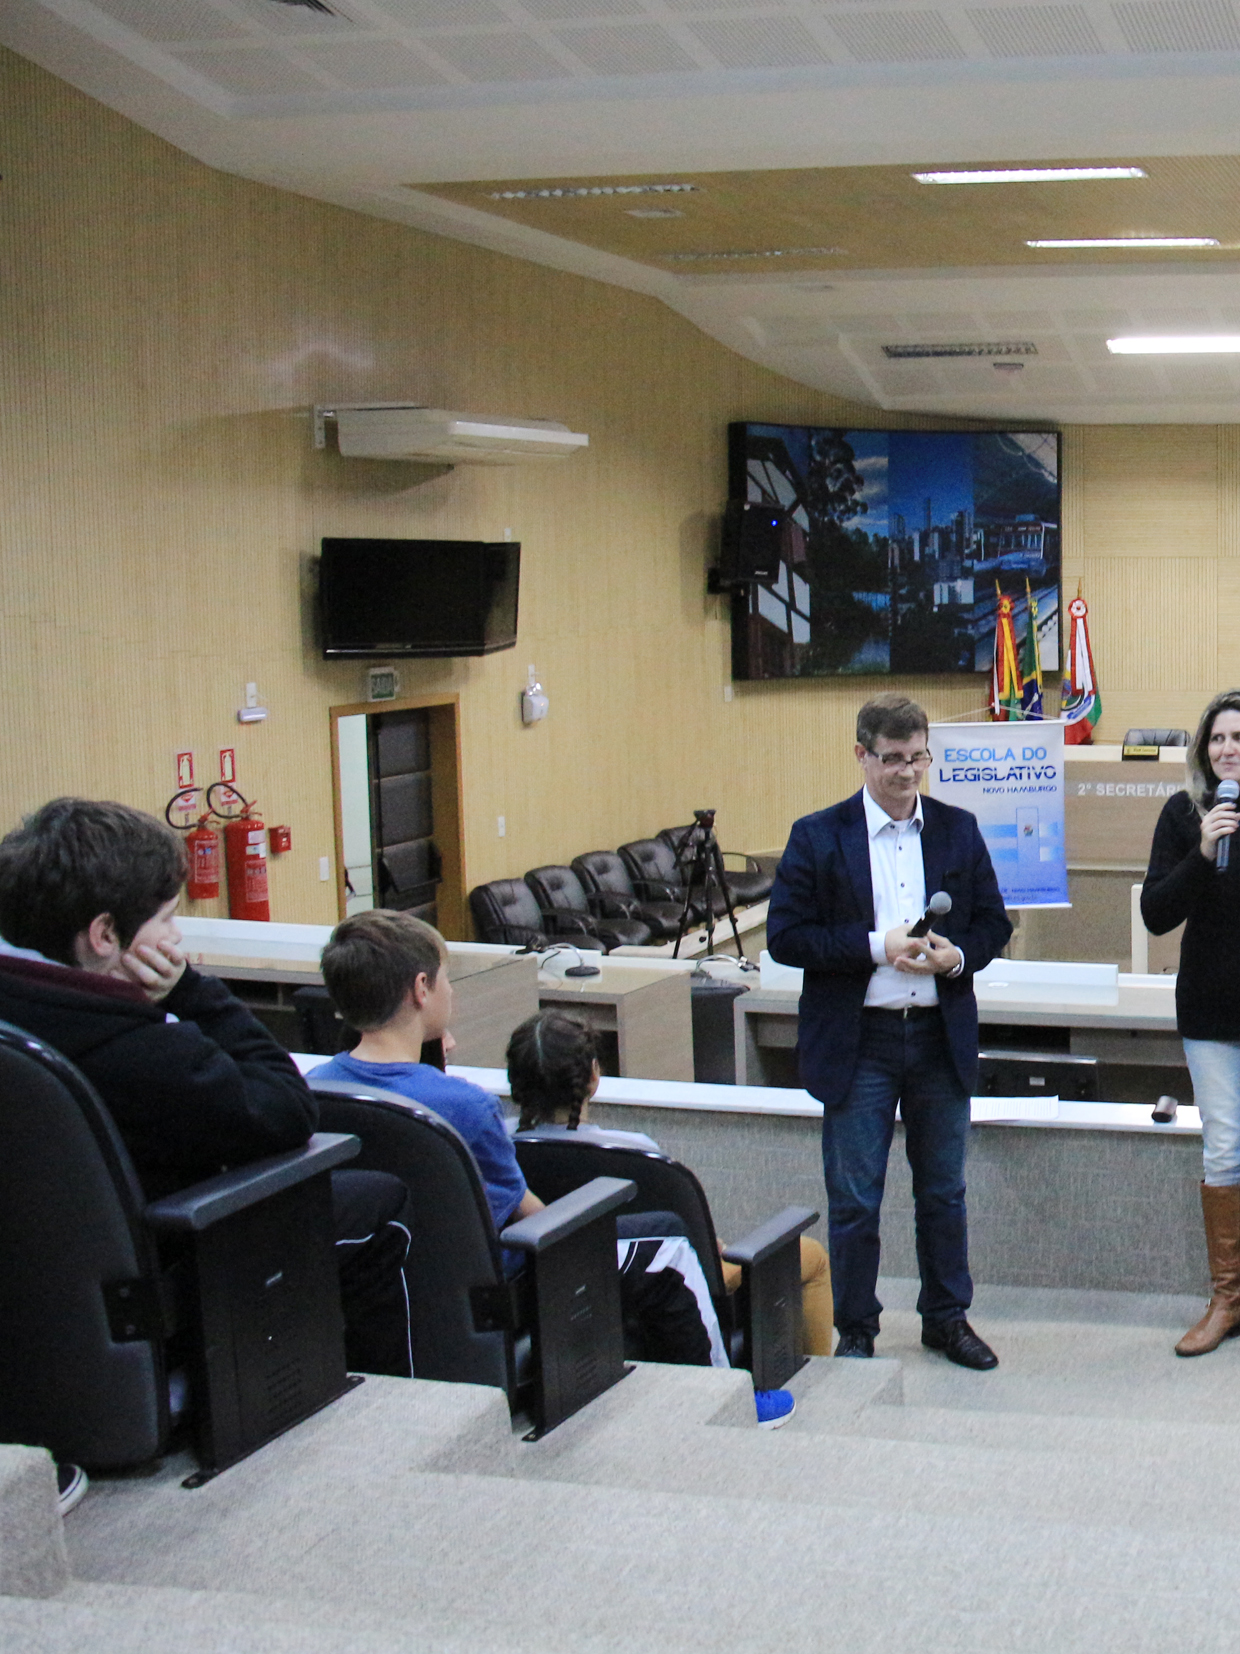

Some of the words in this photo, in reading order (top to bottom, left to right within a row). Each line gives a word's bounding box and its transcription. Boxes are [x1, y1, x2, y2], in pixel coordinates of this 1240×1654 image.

[944, 747, 1016, 763] ESCOLA
[1022, 747, 1047, 761] DO
[939, 765, 1057, 783] LEGISLATIVO
[982, 786, 1005, 795] NOVO
[1007, 785, 1058, 794] HAMBURGO
